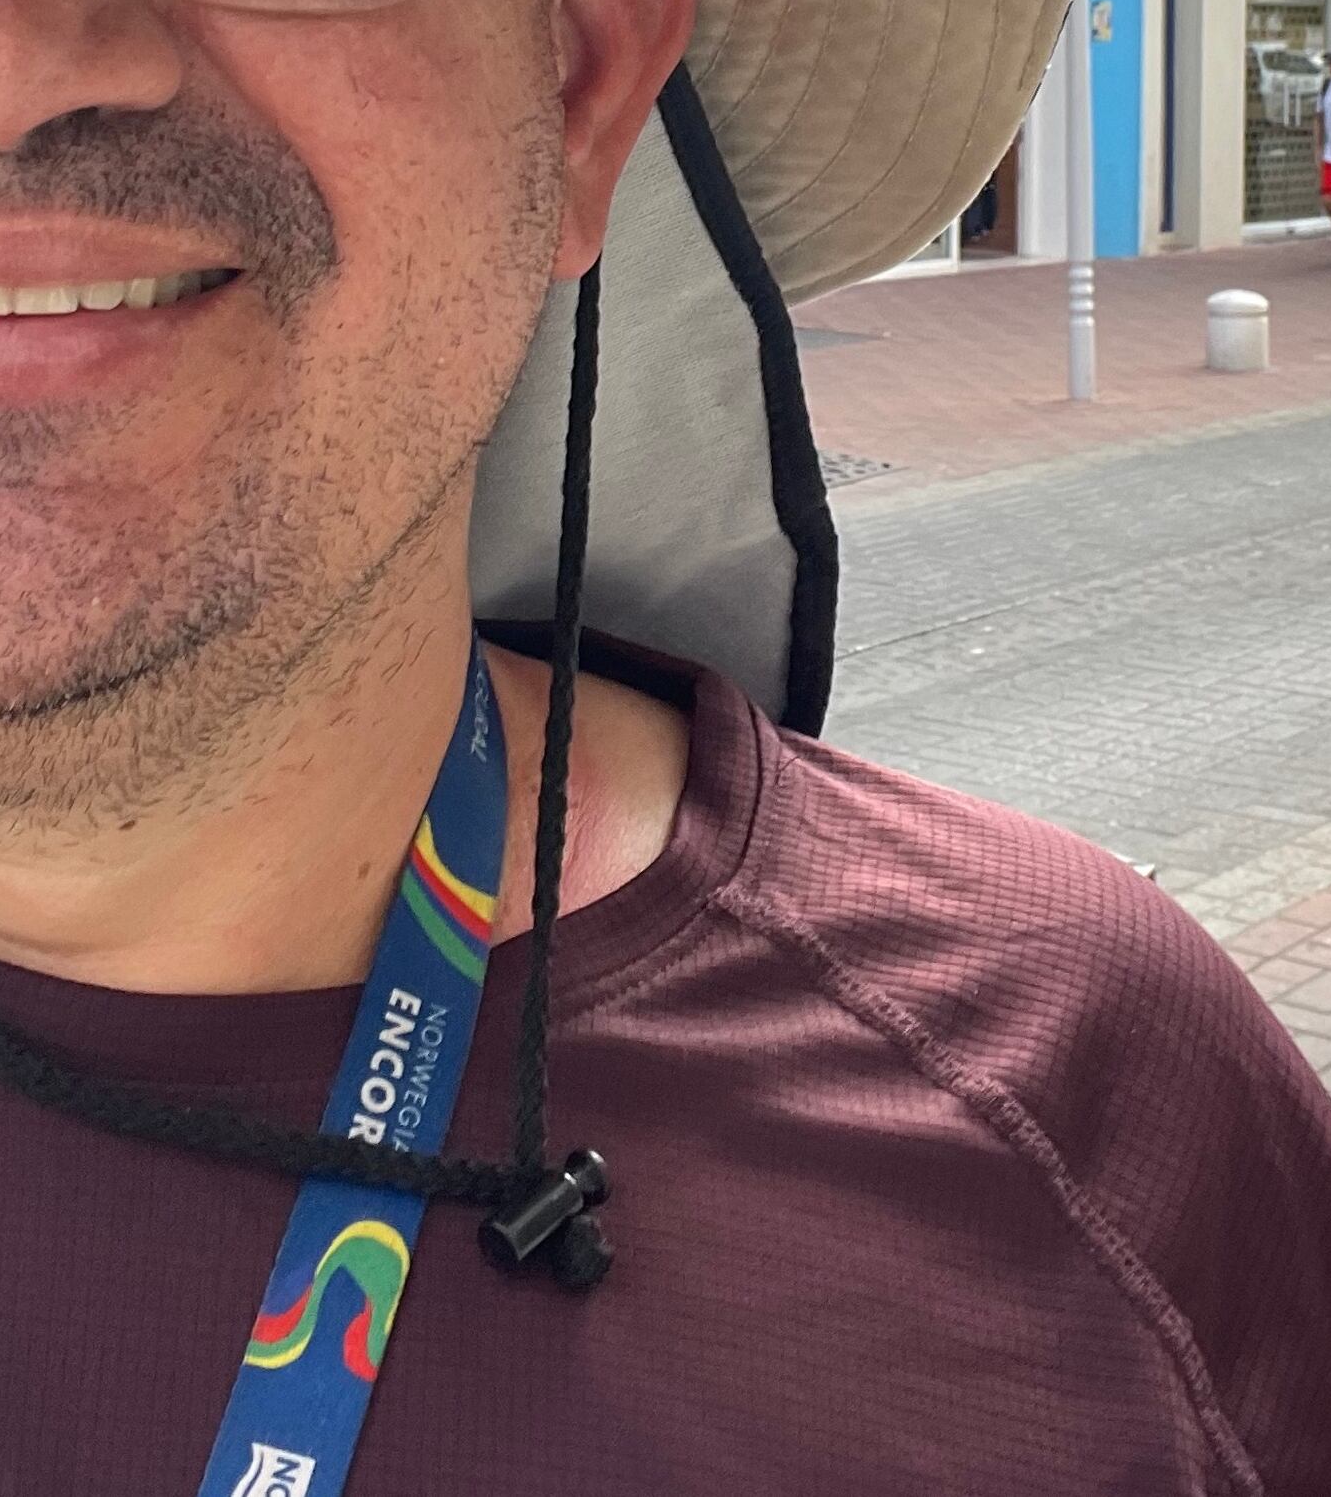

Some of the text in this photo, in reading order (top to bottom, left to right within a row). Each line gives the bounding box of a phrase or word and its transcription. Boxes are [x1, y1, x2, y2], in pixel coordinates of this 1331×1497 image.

[348, 988, 422, 1145] ENCOR
[392, 1003, 449, 1152] NORWEGIA
[266, 1457, 301, 1497] NC
